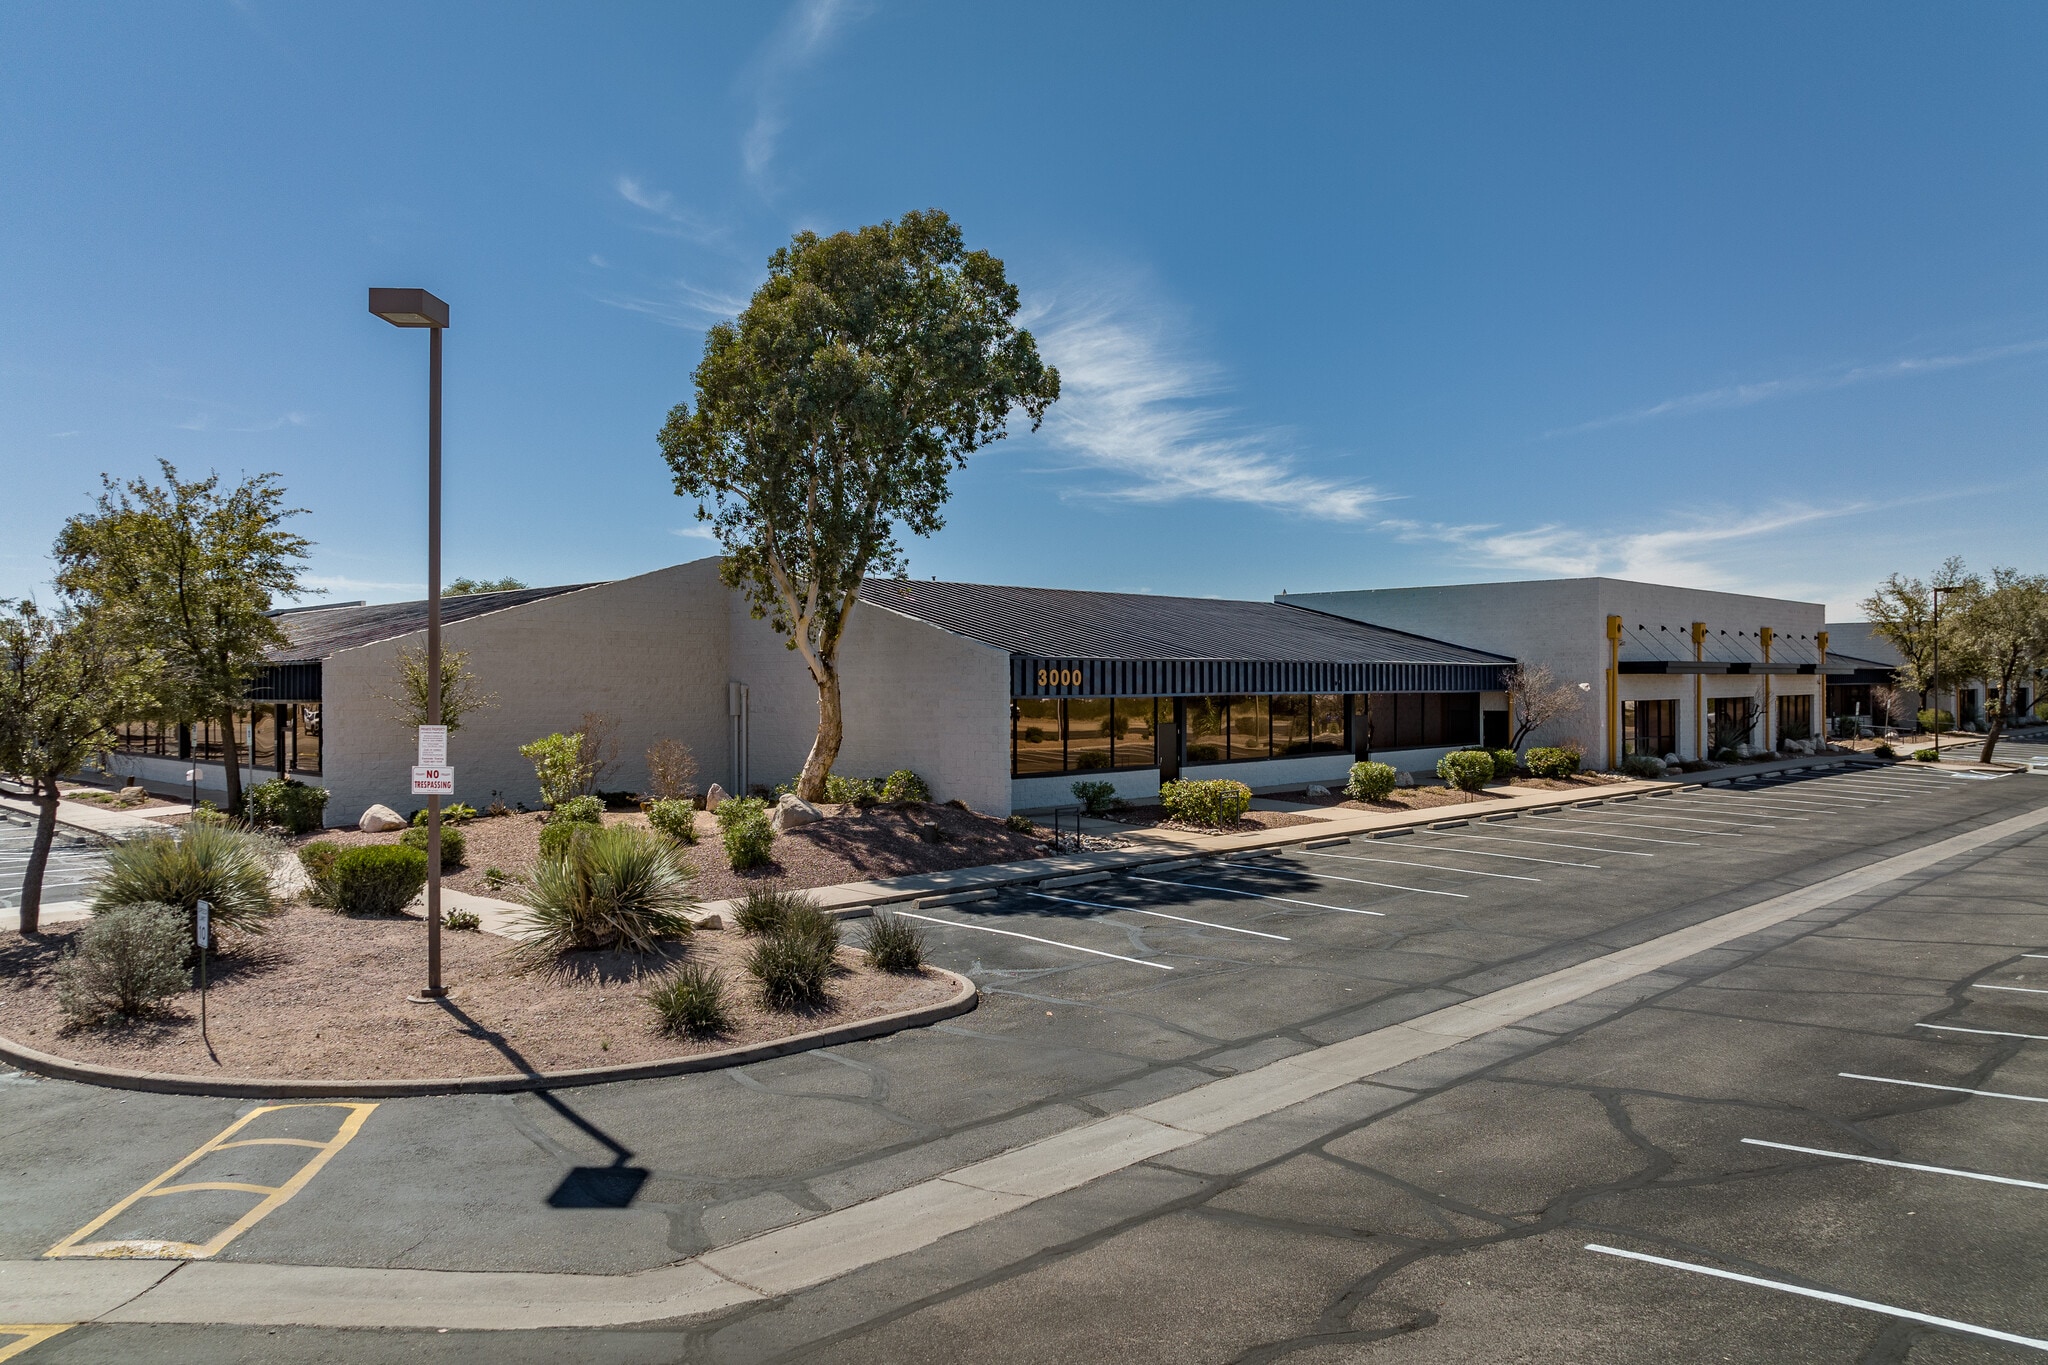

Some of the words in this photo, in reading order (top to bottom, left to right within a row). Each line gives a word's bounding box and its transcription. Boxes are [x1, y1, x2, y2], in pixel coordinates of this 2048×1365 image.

[1038, 669, 1082, 686] 3000
[426, 770, 439, 778] NO
[414, 781, 452, 789] TRESPASSING
[199, 926, 206, 940] 10
